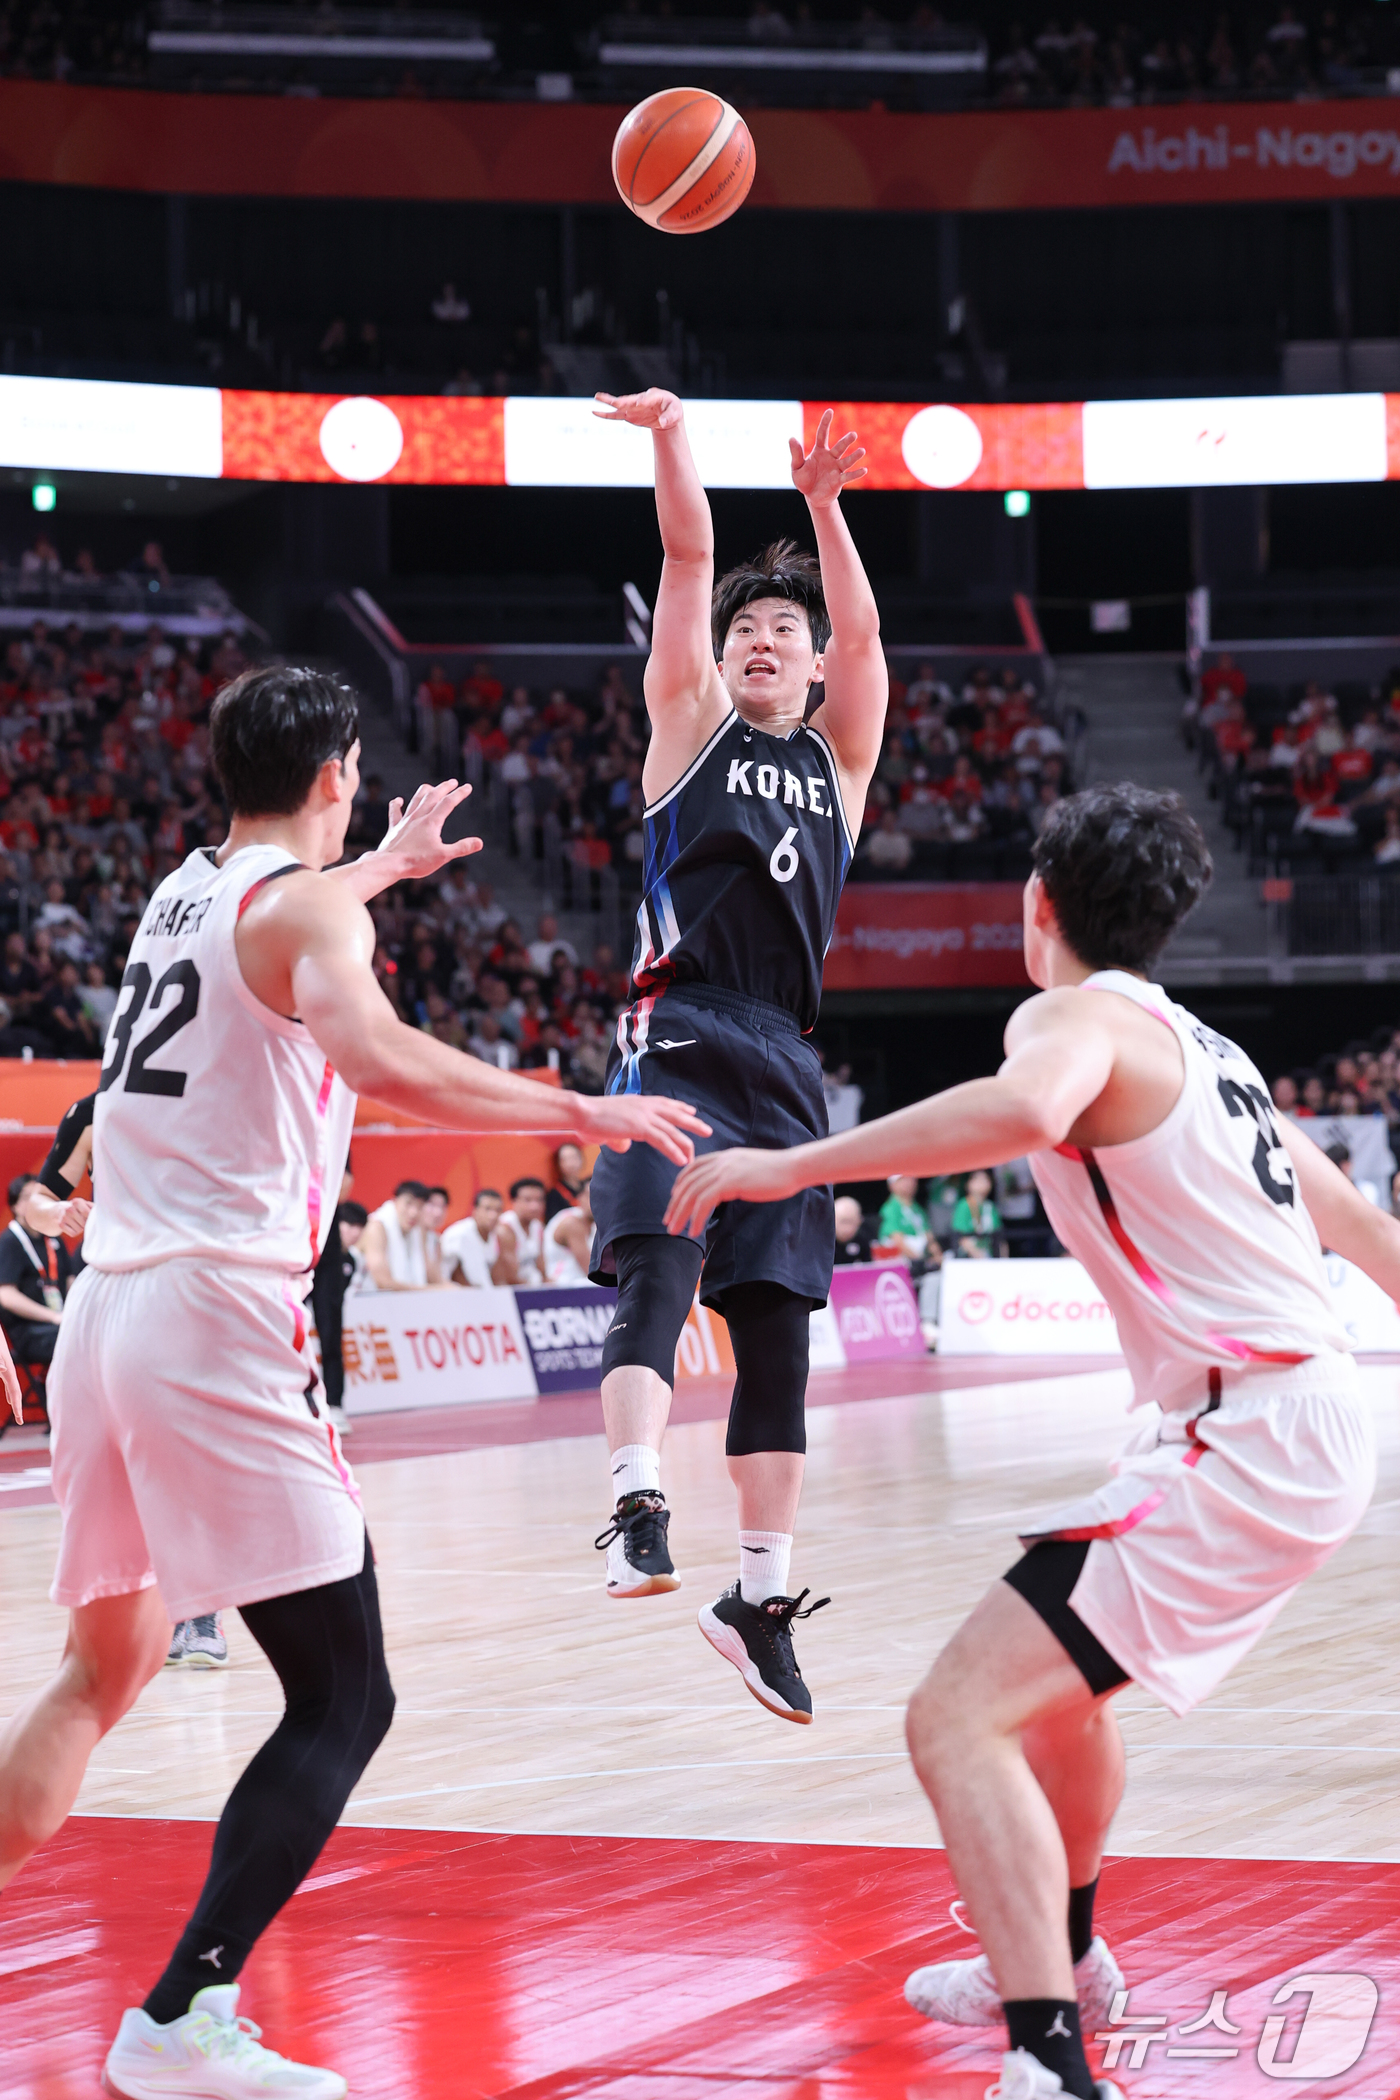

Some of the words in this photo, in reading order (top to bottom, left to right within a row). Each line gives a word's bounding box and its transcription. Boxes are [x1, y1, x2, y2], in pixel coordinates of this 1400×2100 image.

[726, 758, 833, 818] KORE
[769, 826, 799, 883] 6
[971, 922, 1024, 950] 202
[100, 959, 201, 1098] 32
[403, 1324, 522, 1371] TOYOTA
